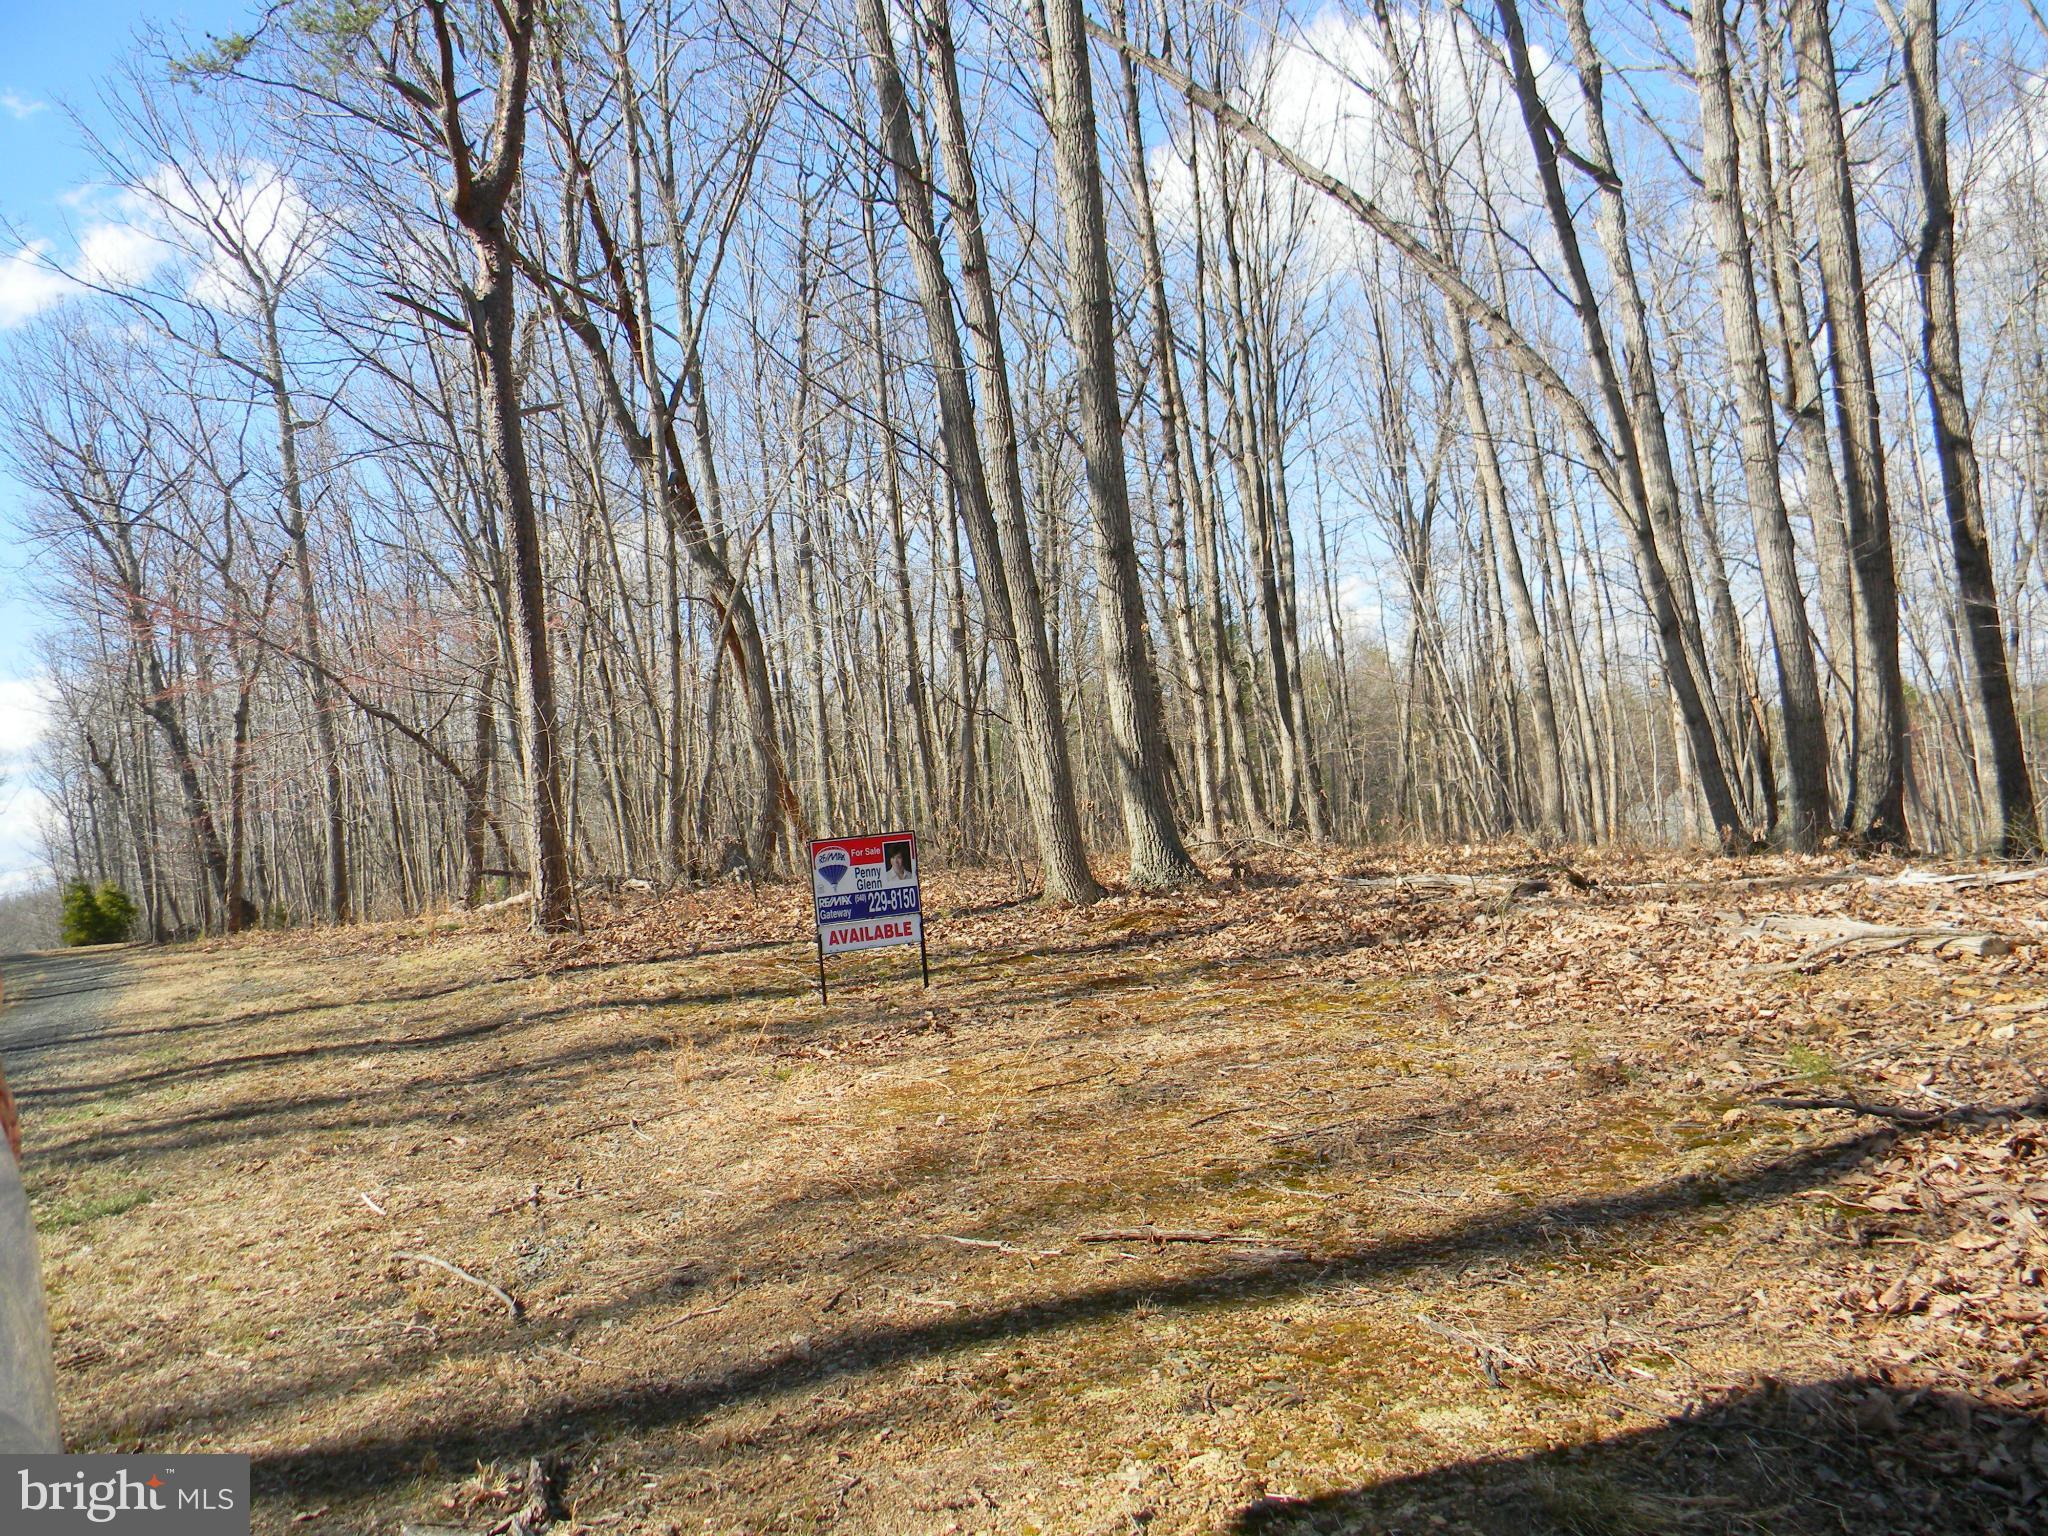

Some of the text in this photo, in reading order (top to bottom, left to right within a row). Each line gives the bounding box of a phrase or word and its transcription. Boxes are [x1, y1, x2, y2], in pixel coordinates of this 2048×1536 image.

[851, 847, 880, 856] For Sale
[855, 867, 881, 879] Penny
[857, 879, 882, 890] Glenn
[819, 895, 852, 908] RE/MAX
[868, 888, 915, 912] 229-8150
[820, 909, 851, 920] Gateway
[829, 922, 912, 945] AVAILABLE
